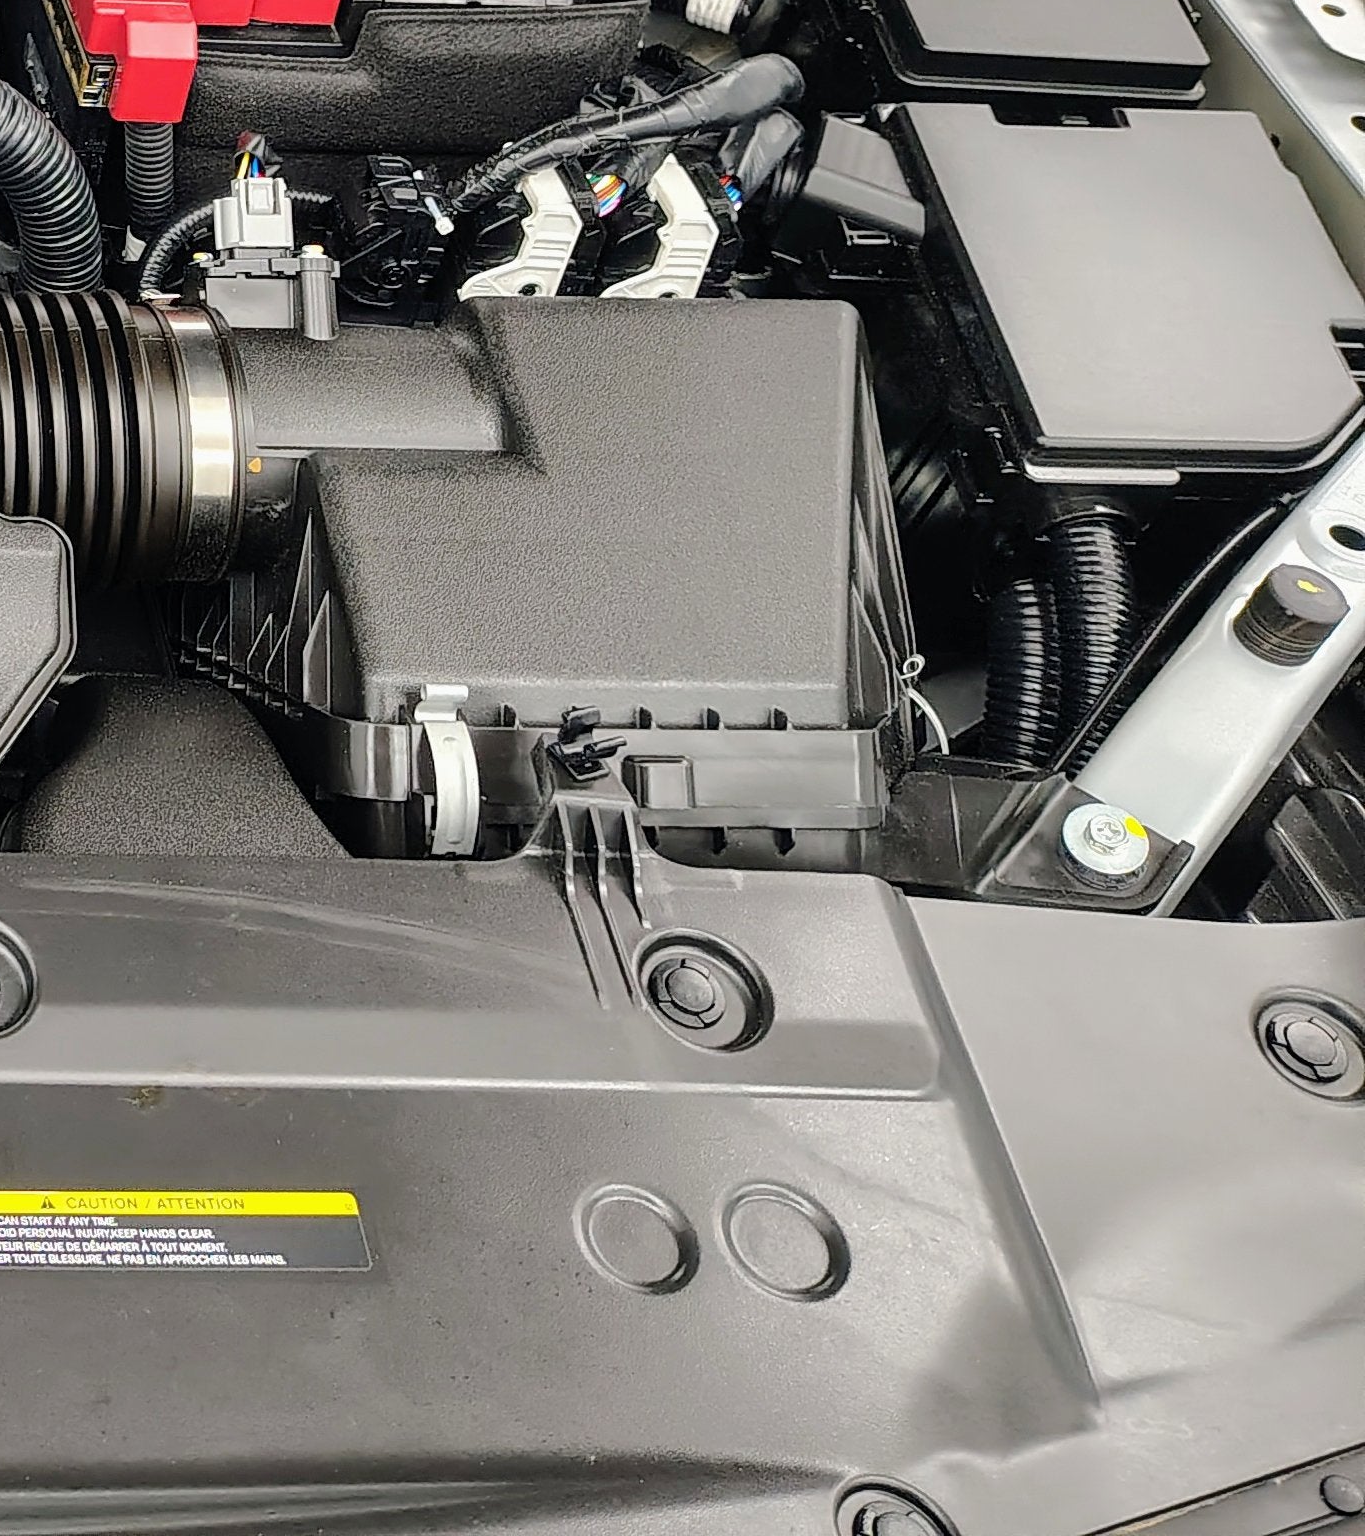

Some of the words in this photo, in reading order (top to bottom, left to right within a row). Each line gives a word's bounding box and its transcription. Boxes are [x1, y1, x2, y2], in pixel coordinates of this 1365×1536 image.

[66, 1196, 138, 1210] CAUTION
[157, 1196, 245, 1210] ATTENTION
[20, 1216, 53, 1226] START
[54, 1216, 66, 1226] AT
[68, 1216, 89, 1226] ANY
[91, 1216, 118, 1227] TIME.
[18, 1227, 74, 1239] PERSONAL
[139, 1228, 177, 1239] HANDS
[178, 1228, 215, 1239] CLEAR.
[25, 1241, 65, 1252] RISQUE
[66, 1241, 80, 1252] DE
[141, 1239, 150, 1253] À
[150, 1242, 178, 1253] TOUT
[179, 1242, 228, 1253] MOMENT.
[12, 1253, 46, 1264] TOUTE
[48, 1253, 106, 1266] BLESSURE,
[107, 1254, 121, 1265] NE
[123, 1254, 145, 1265] PAS
[146, 1254, 161, 1265] EN
[163, 1254, 228, 1265] APPROCHER
[229, 1255, 250, 1265] LES
[250, 1255, 287, 1265] MAINS.
